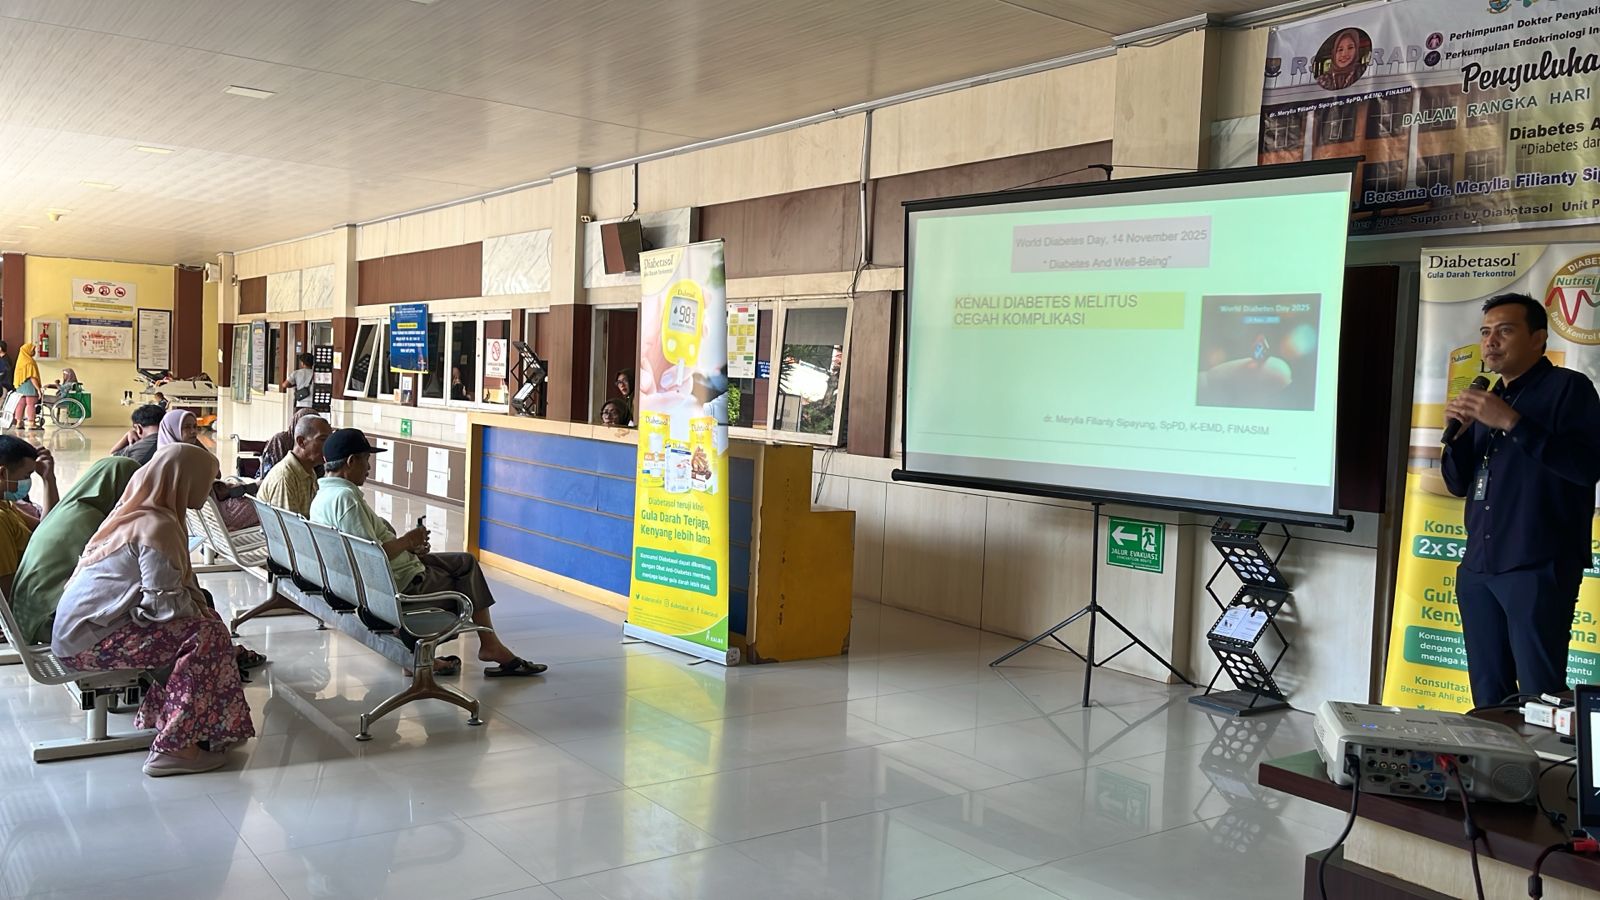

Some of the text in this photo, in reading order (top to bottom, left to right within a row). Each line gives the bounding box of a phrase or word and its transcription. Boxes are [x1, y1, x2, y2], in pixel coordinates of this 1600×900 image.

[1450, 22, 1514, 41] Perhimpunan
[1517, 15, 1553, 28] Dokter
[1446, 43, 1510, 60] Perkumpulan
[1513, 28, 1586, 48] Endokrinologi
[1461, 47, 1600, 93] Penyuluha
[1403, 87, 1590, 126] DALAM RANGKA HARI
[1510, 122, 1584, 140] Diabetes
[1365, 188, 1426, 203] Bersama
[1430, 184, 1451, 197] dr.
[1456, 179, 1510, 194] Merylla
[1516, 172, 1577, 185] Filianty
[1411, 212, 1460, 225] Support
[1463, 210, 1478, 220] by
[1482, 203, 1553, 218] Diabetasol
[1562, 200, 1588, 212] Unit
[1016, 230, 1208, 247] World Diabetes Day, 14 November 2025
[1092, 257, 1112, 268] And
[1429, 252, 1516, 269] Diabetasol
[1427, 271, 1444, 279] Gula
[1473, 270, 1516, 278] Terkontrol
[1556, 276, 1595, 286] Nutrisi
[955, 294, 1138, 309] KENALI DIABETES MELITUS
[1219, 305, 1241, 313] World
[1275, 304, 1290, 313] Day
[1291, 303, 1311, 312] 2025
[954, 312, 1085, 325] CEGAH KOMPLIKASI
[1551, 311, 1596, 340] Bantu Kontrol
[1043, 414, 1054, 423] dr.
[1086, 416, 1114, 428] Filianty
[1160, 420, 1188, 431] SpPD,
[1190, 422, 1225, 434] K-EMD,
[1228, 424, 1270, 436] FINASIM
[648, 497, 676, 507] Diabetasol
[641, 510, 710, 530] Gula Darah Terjaga,
[641, 524, 711, 545] Kenyang lebih lama
[1111, 548, 1158, 560] JALUR EVAKUASI
[1419, 539, 1443, 556] 2x
[1419, 631, 1460, 645] Konsumsi
[1420, 642, 1453, 653] dengan
[1421, 653, 1458, 665] menjaga
[1415, 676, 1469, 692] Konsultasi
[1401, 685, 1471, 704] Bersama Ahli gizi
